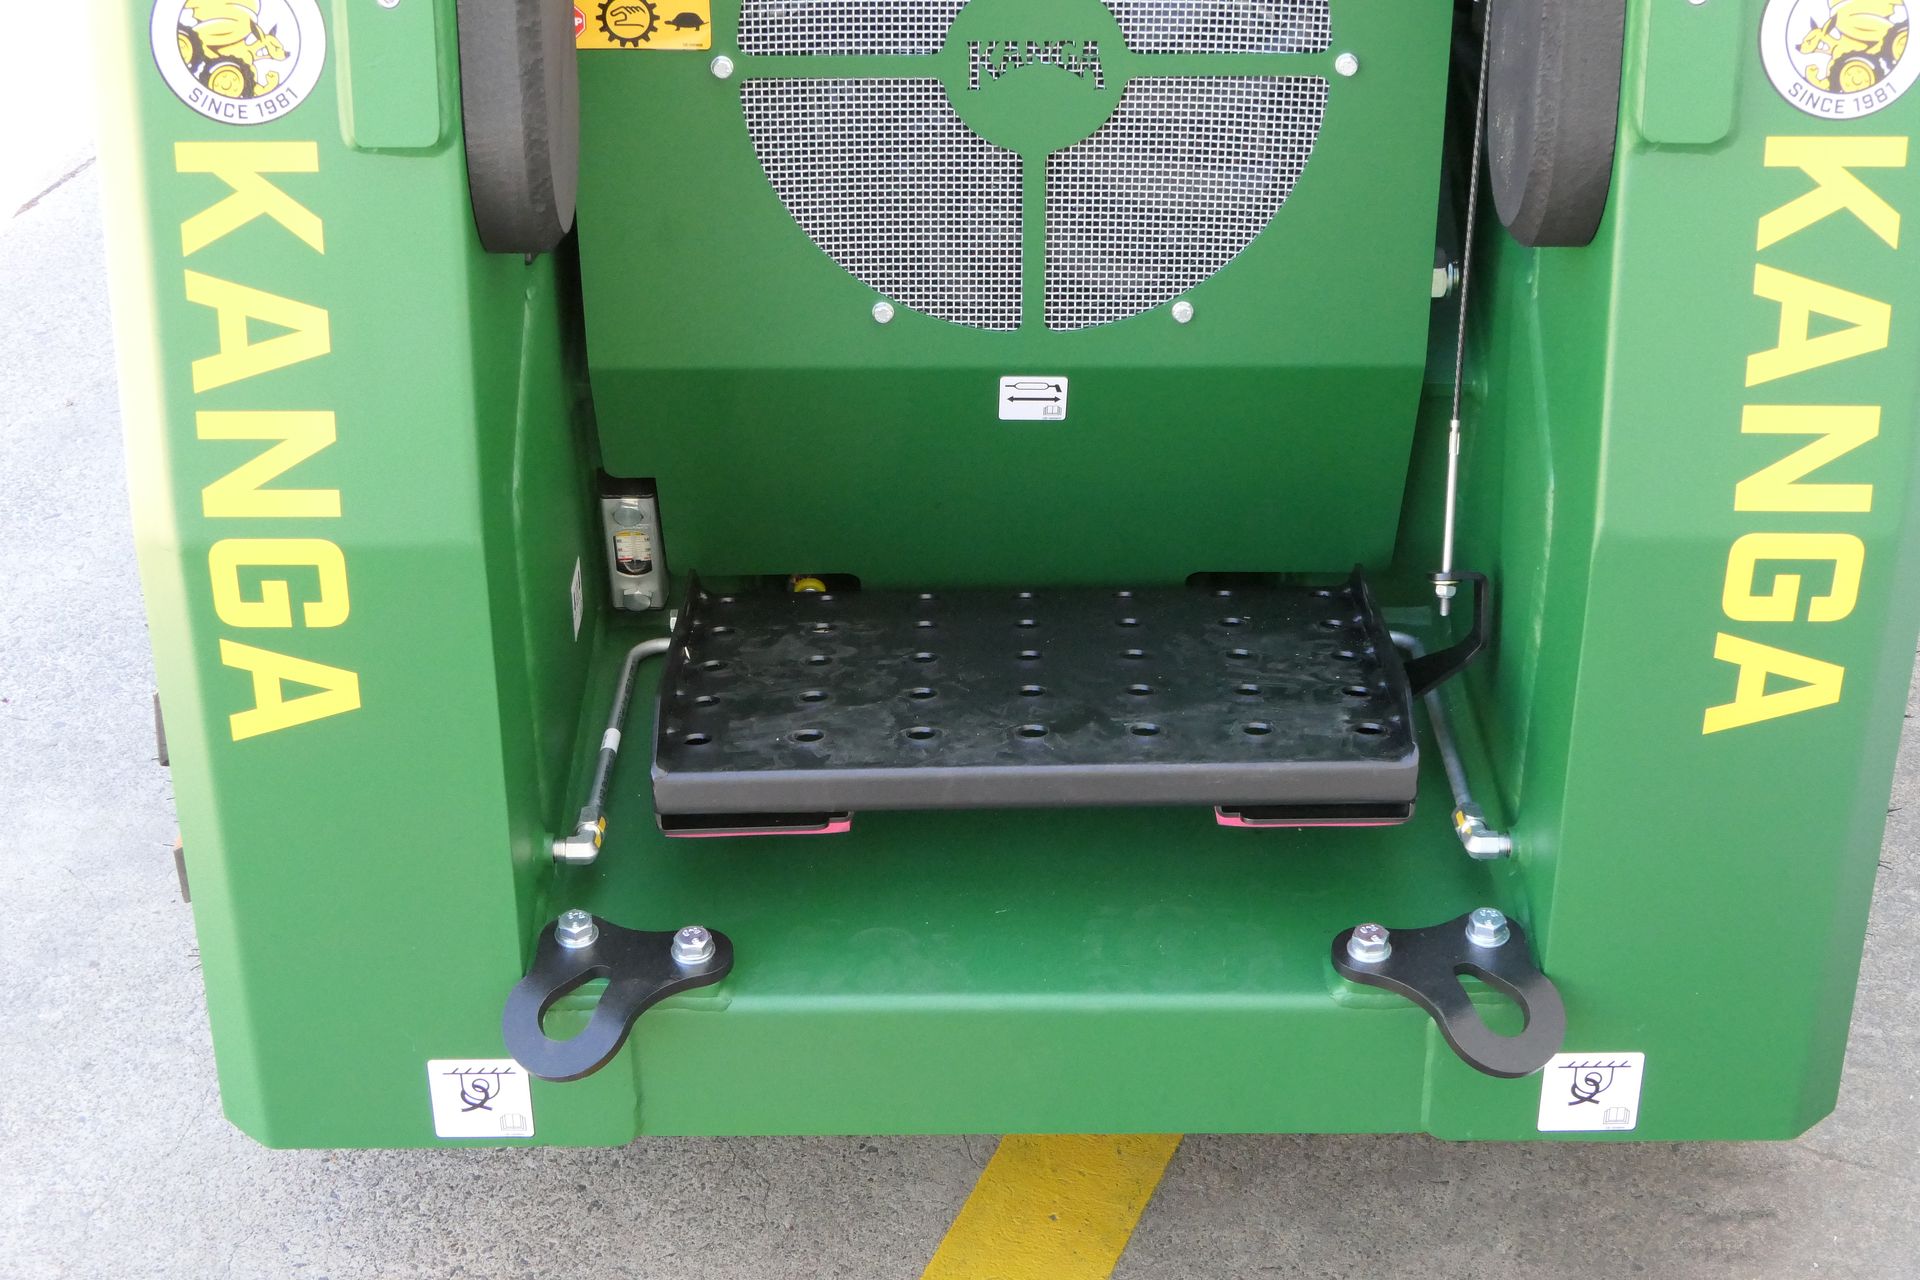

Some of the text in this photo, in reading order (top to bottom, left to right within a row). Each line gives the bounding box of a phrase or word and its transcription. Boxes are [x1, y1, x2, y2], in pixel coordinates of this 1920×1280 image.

[967, 40, 1107, 90] KANGA
[188, 87, 298, 119] SINCE 1981
[1788, 82, 1897, 114] SINCE 1981
[174, 141, 361, 742] KANGA
[1701, 136, 1909, 735] KANGA
